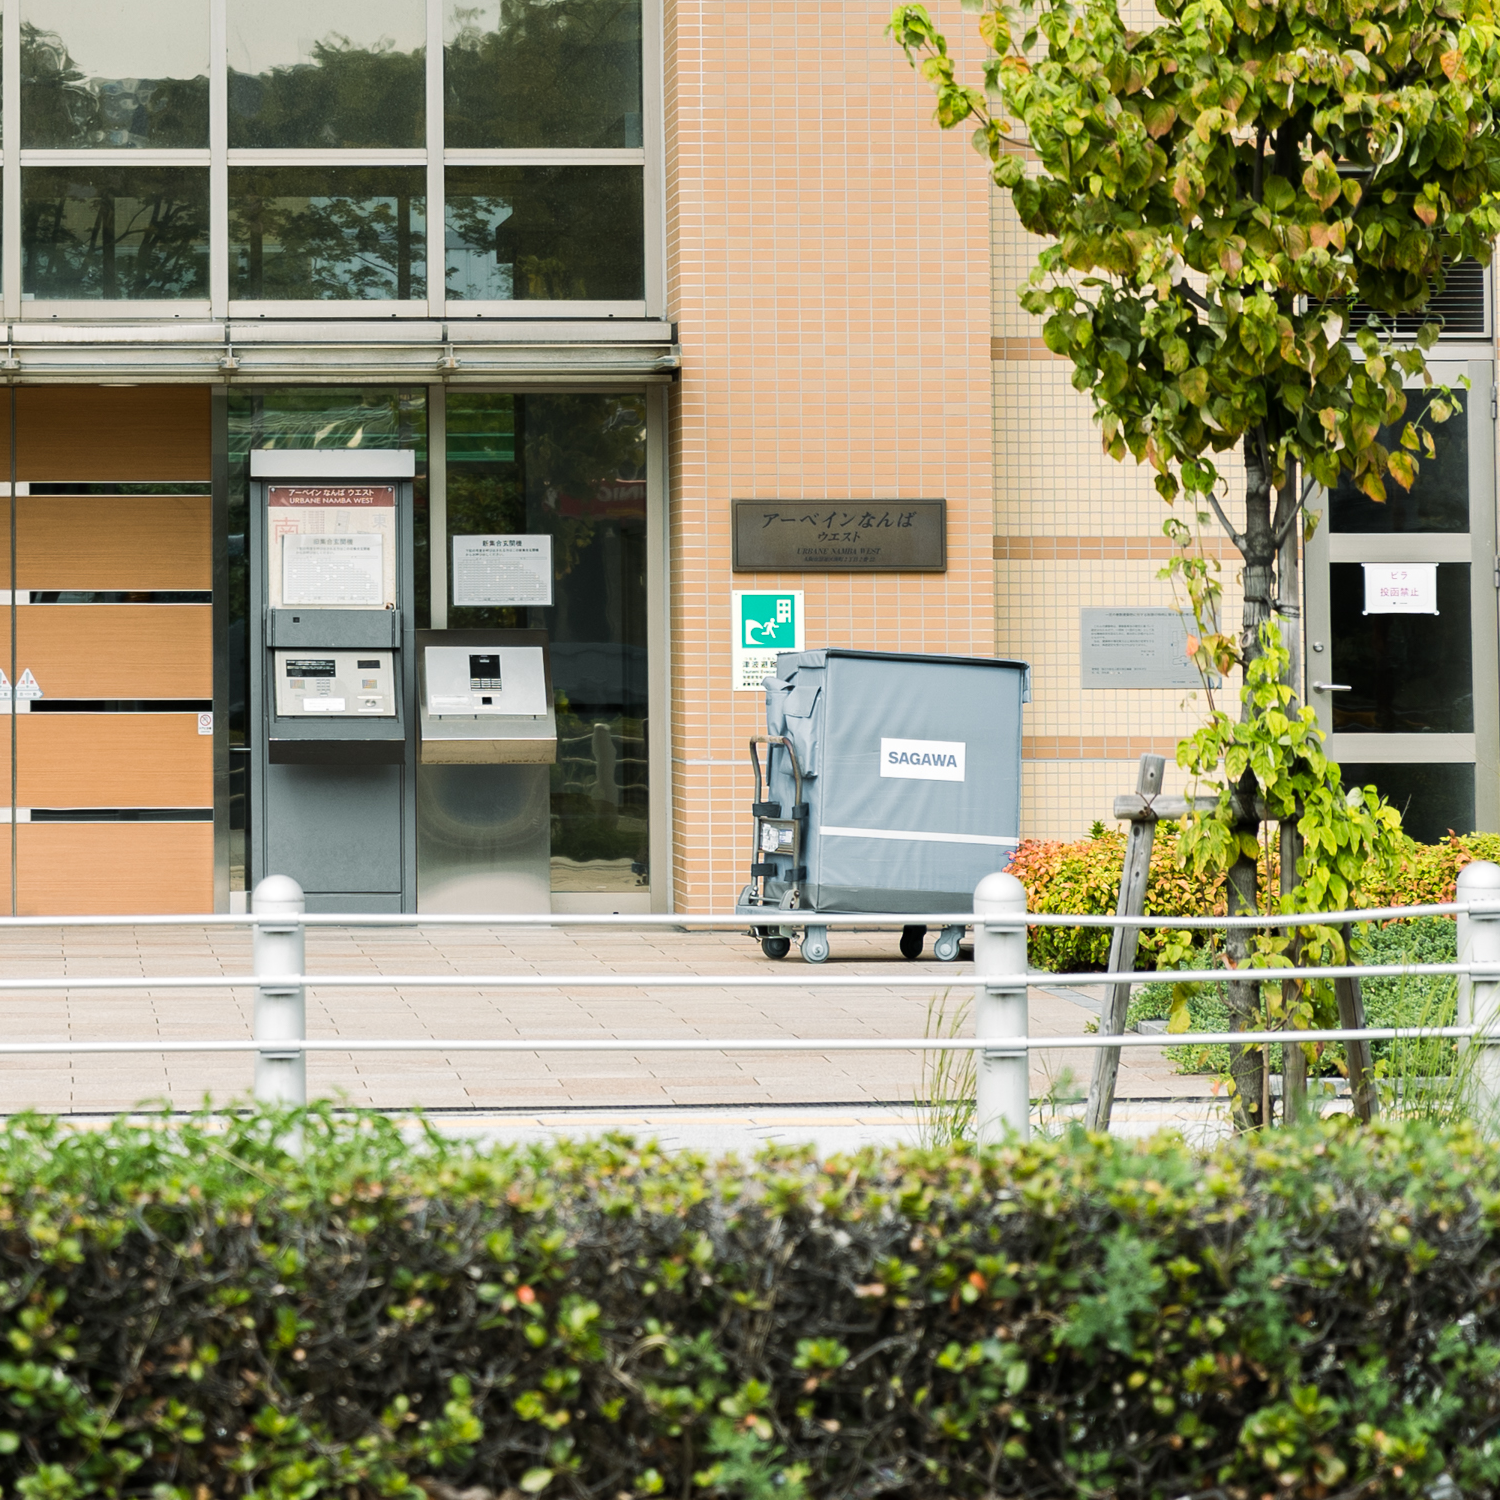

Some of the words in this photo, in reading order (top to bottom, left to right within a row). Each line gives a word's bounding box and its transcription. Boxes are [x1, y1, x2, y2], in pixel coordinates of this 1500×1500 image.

[288, 488, 322, 497] アーベイン
[323, 488, 346, 497] なんば
[347, 488, 375, 497] ウエスト
[762, 511, 917, 529] アーベインなんば
[817, 531, 861, 543] ウエスト
[1380, 587, 1419, 597] 投函禁止
[888, 751, 957, 768] SAGAWA
